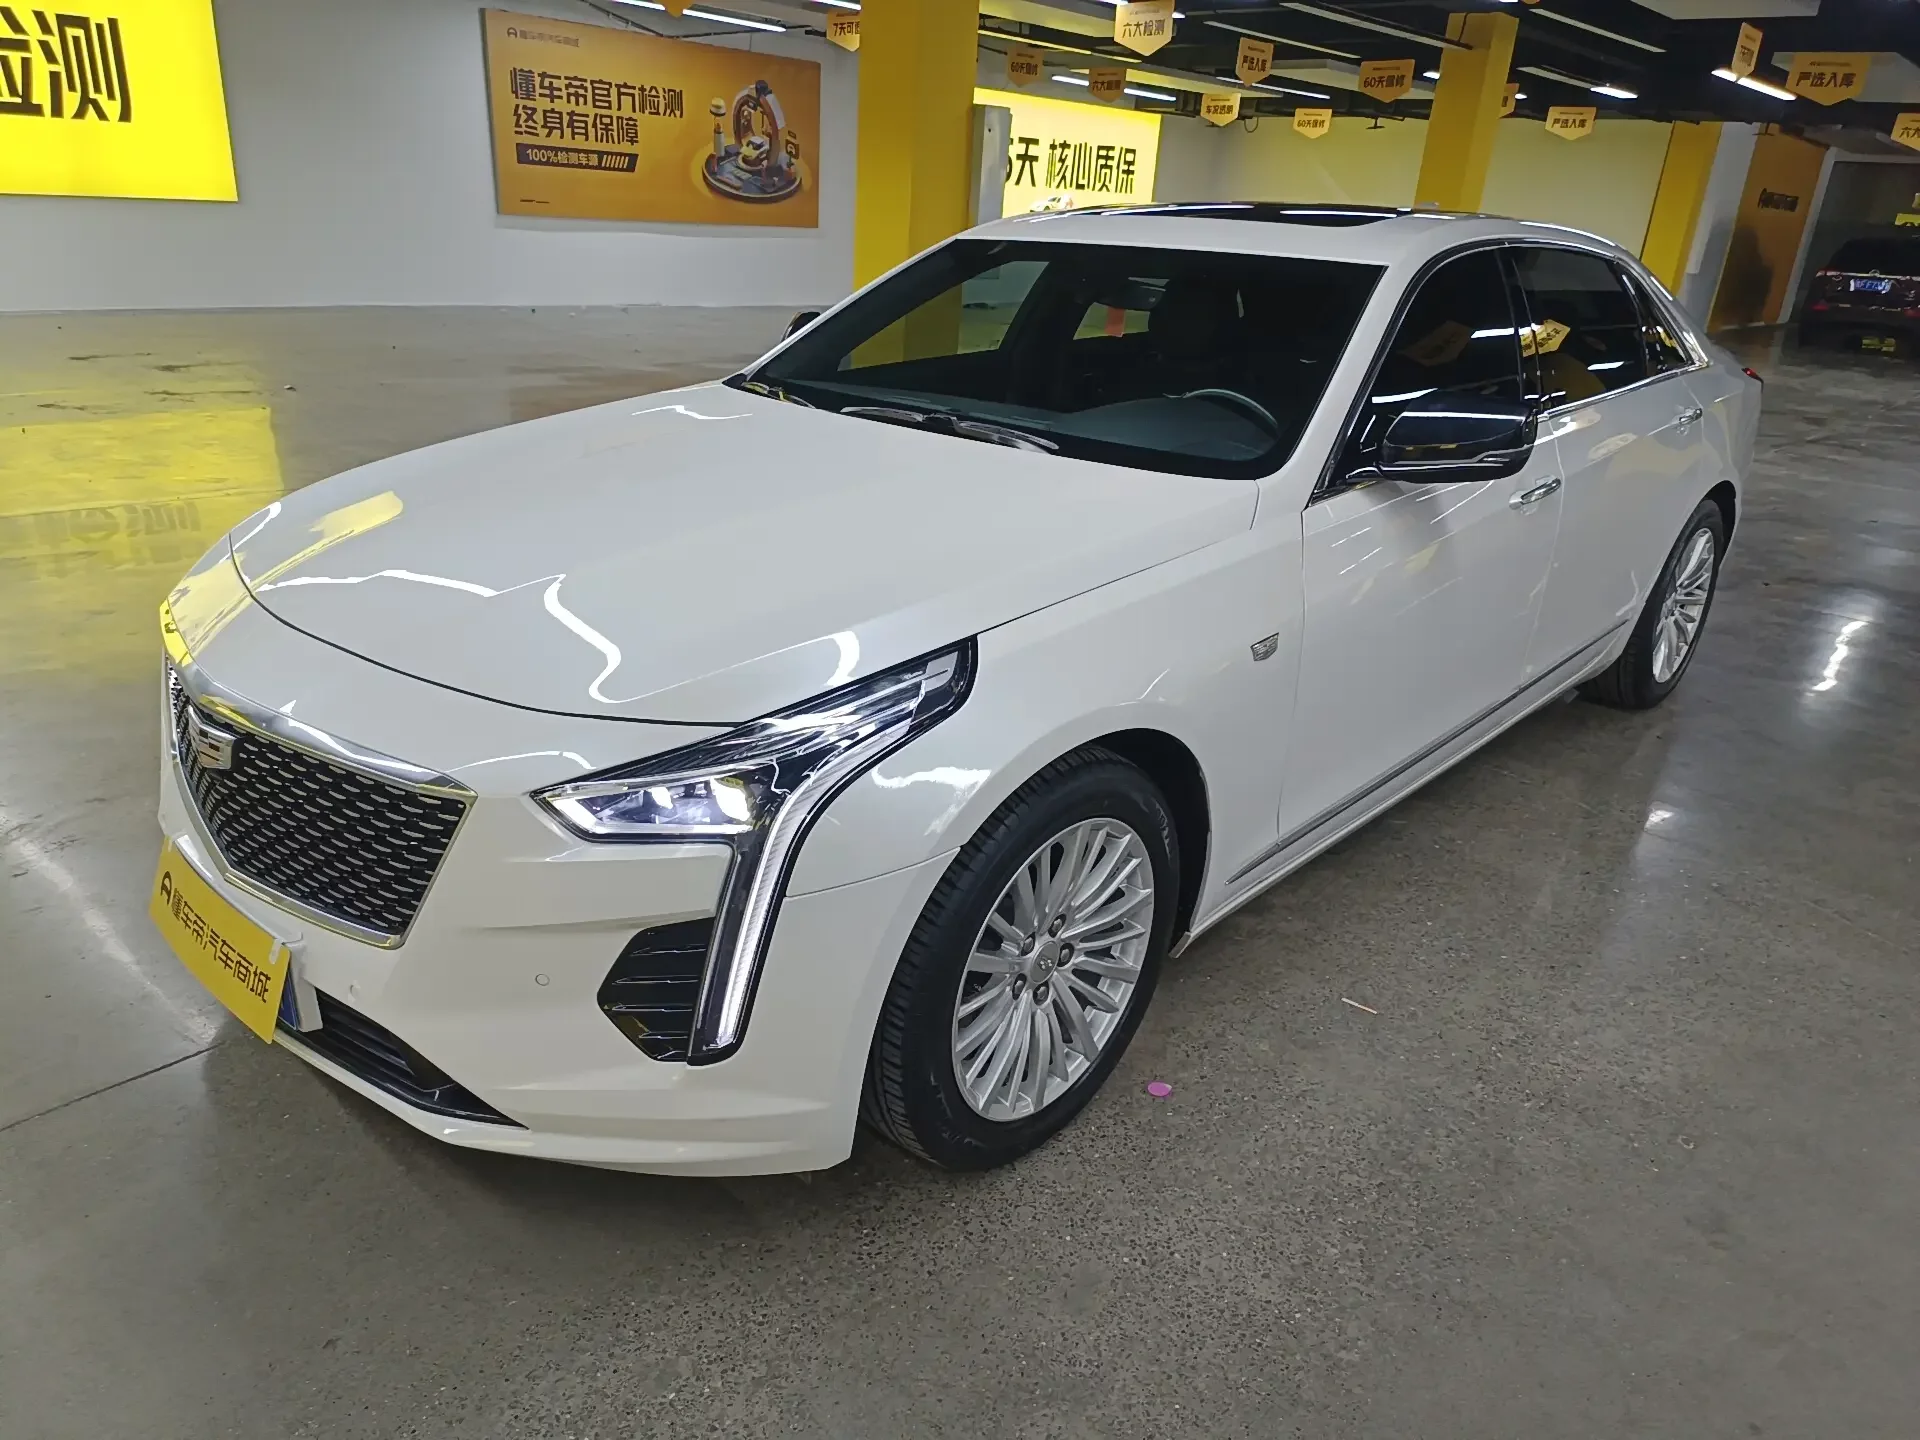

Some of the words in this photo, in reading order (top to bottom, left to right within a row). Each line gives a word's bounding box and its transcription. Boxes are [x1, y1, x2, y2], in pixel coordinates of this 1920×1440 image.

[1122, 19, 1165, 38] 六大检测
[510, 66, 683, 119] 懂车帝官方检测
[1795, 71, 1857, 88] 严选入库
[513, 104, 639, 146] 终身有保障
[1551, 118, 1587, 128] 严选入库
[526, 149, 599, 166] 100%检测车源
[1006, 136, 1039, 187] 天
[1045, 138, 1136, 194] 核心质保
[172, 887, 271, 1003] 懂车帝汽车商城
